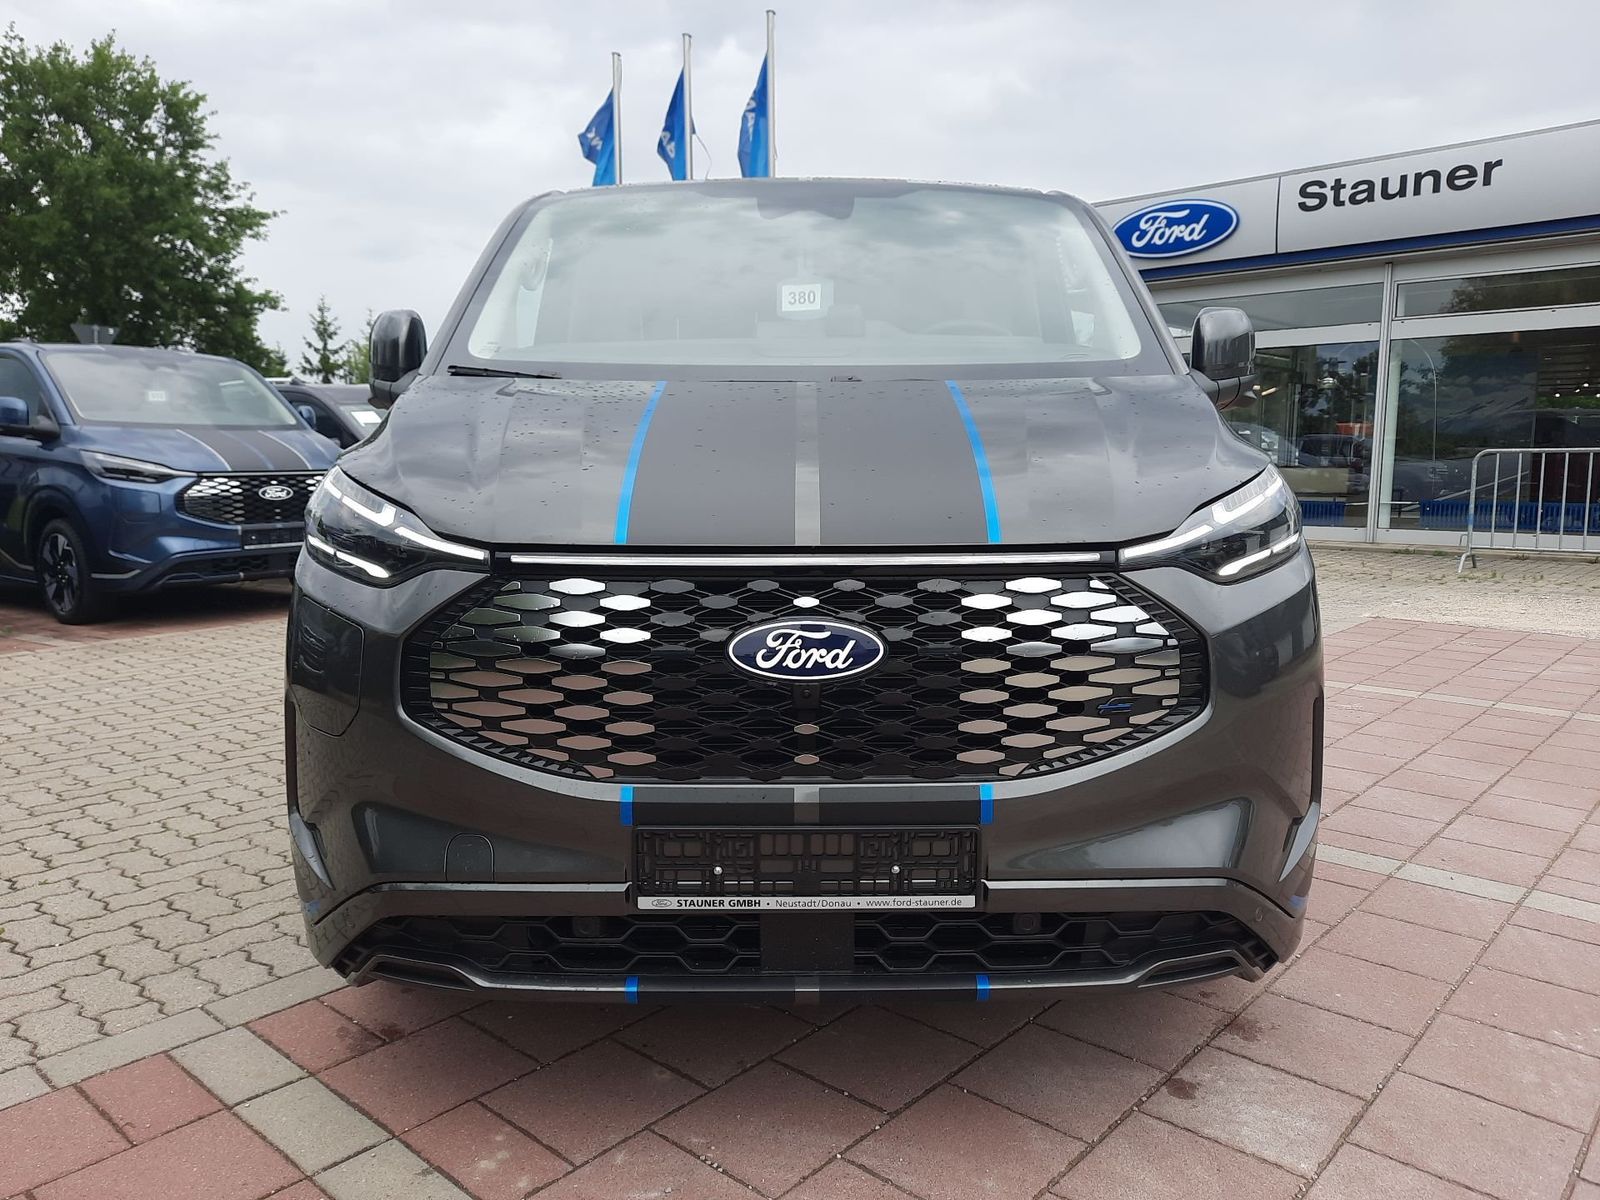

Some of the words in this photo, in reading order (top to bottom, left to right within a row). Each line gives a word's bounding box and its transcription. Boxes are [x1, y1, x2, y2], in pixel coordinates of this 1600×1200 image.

[1298, 158, 1503, 212] Stauner
[1131, 209, 1210, 248] Ford
[788, 290, 816, 305] 380
[755, 629, 857, 669] Ford
[676, 899, 725, 908] STAUNER
[728, 899, 761, 908] GMBH
[775, 899, 852, 908] Neustadt/Donau
[866, 897, 962, 907] www.ford-stauner.de
